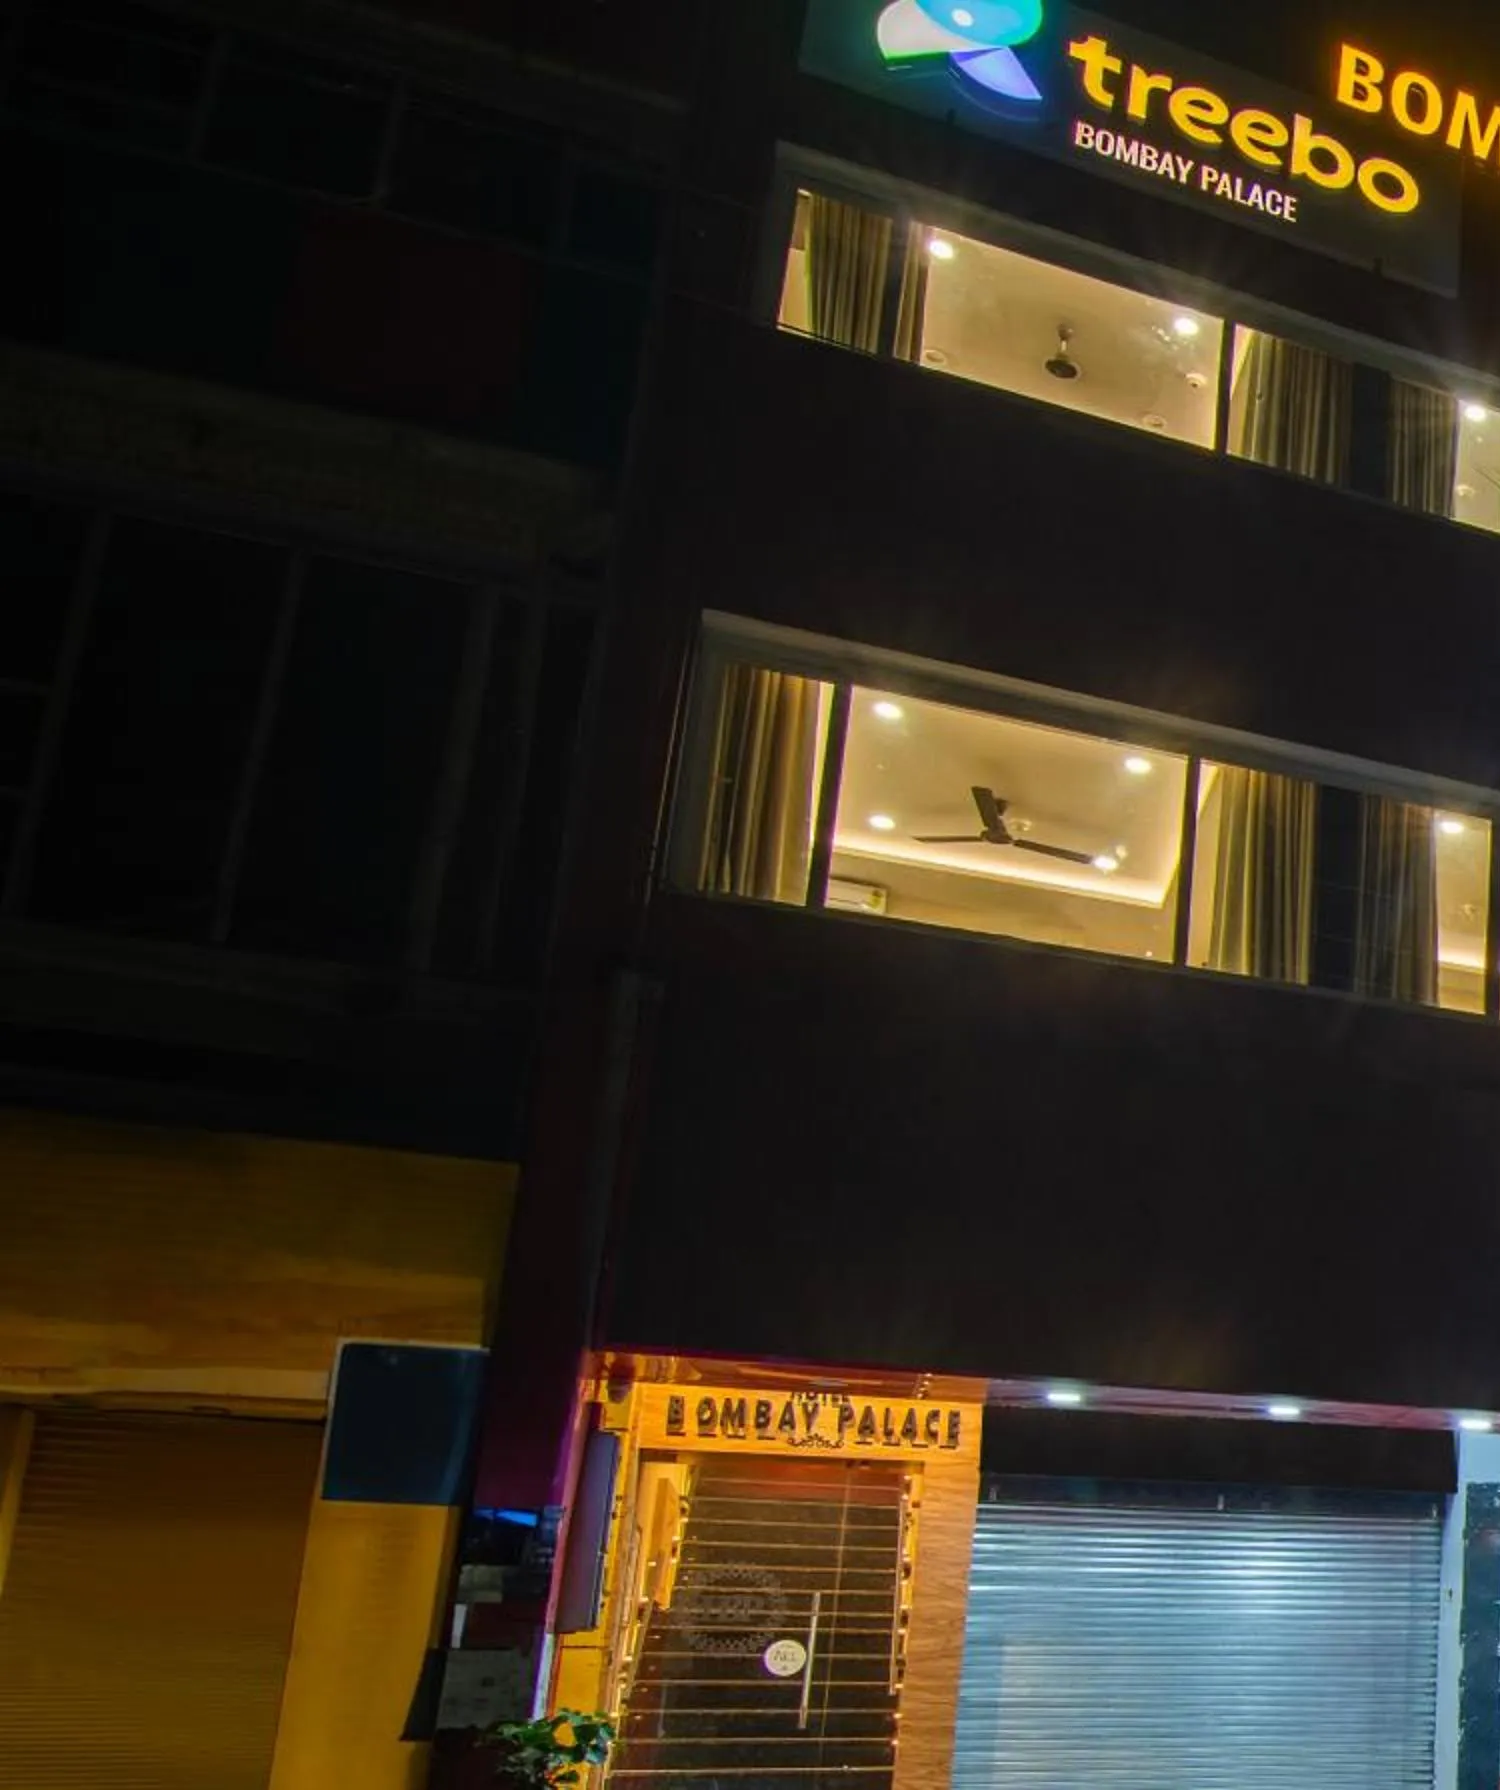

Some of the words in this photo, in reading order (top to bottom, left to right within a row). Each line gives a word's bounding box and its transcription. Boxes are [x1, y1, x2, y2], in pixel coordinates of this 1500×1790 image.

[1068, 35, 1419, 214] treebo
[1074, 120, 1196, 185] BOMBAY
[1201, 164, 1299, 223] PALACE
[667, 1395, 821, 1437] BOMBAY
[837, 1402, 962, 1445] PALACE
